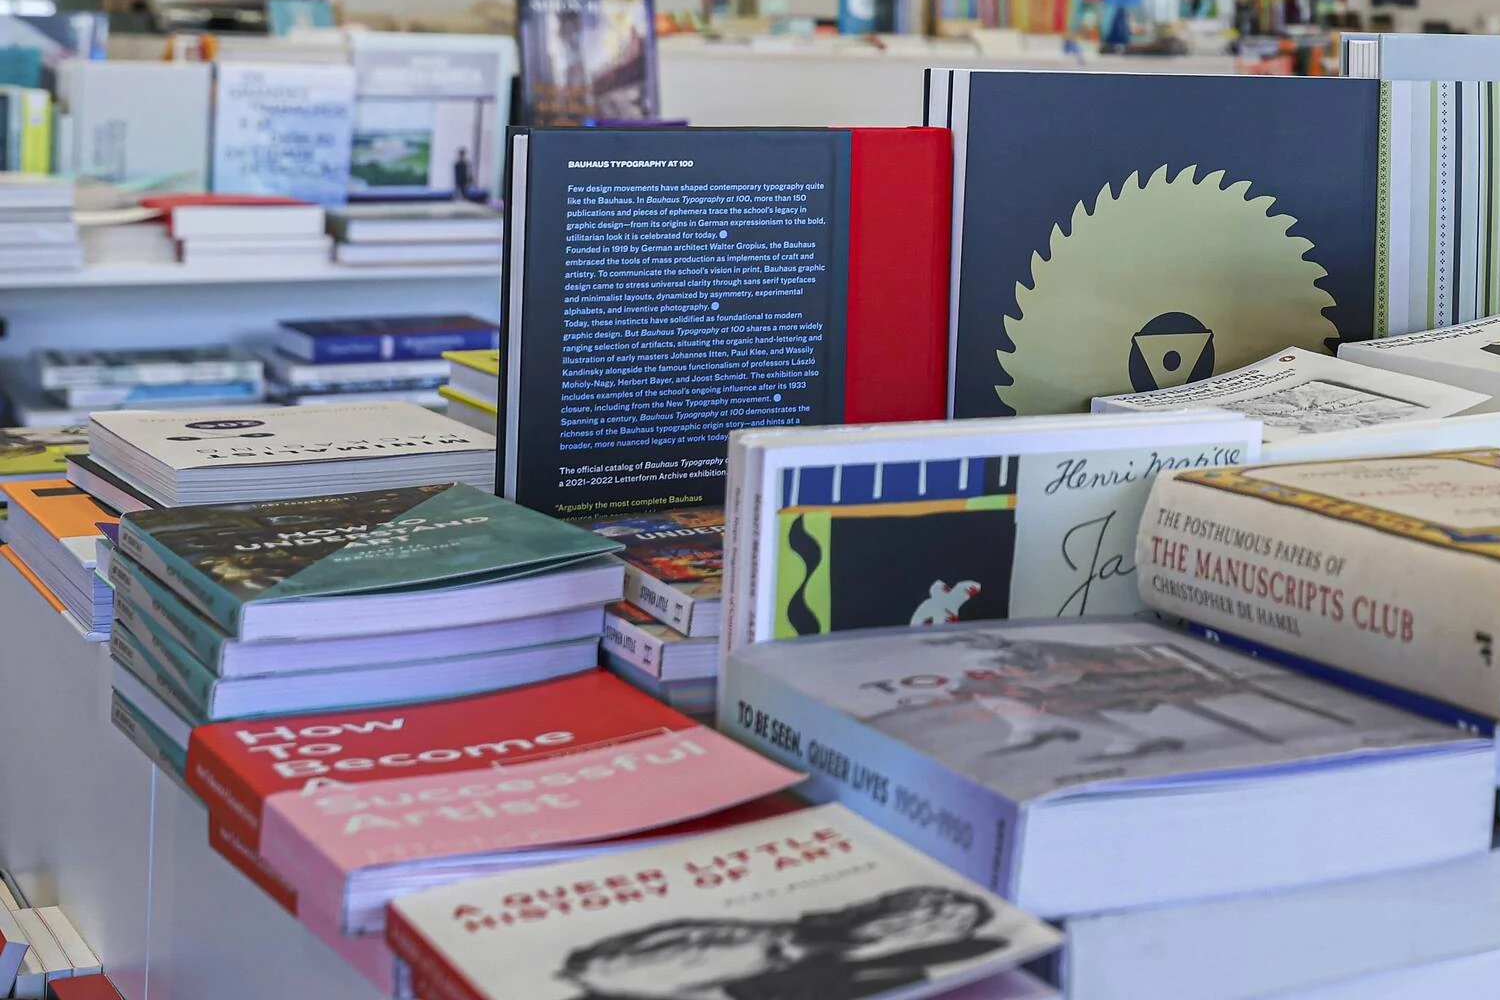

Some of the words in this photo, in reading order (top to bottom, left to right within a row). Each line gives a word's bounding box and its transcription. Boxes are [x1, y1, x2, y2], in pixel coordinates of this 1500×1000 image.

[568, 160, 609, 168] BAUHAUS
[611, 160, 666, 168] TYPOGRAPHY
[667, 160, 679, 168] AT
[680, 160, 694, 168] 100
[567, 184, 584, 193] Few
[586, 184, 612, 194] design
[680, 183, 708, 193] shaped
[709, 183, 761, 193] contemporary
[763, 182, 804, 192] typography
[805, 181, 824, 191] quite
[567, 197, 581, 205] like
[598, 196, 635, 204] Bauhaus.
[636, 196, 645, 204] In
[646, 196, 680, 204] Bauhaus
[681, 195, 725, 206] Typography
[726, 195, 734, 203] at
[735, 195, 753, 204] 100,
[775, 194, 792, 202] than
[234, 516, 489, 551] UNDERSTAND
[276, 523, 369, 541] HOW
[377, 518, 427, 528] TO
[344, 535, 410, 549] ART
[1157, 507, 1180, 529] THE
[1183, 511, 1273, 557] POSTHUMOUS
[1274, 540, 1322, 569] PAPERS
[1324, 555, 1347, 577] OF
[1151, 536, 1190, 574] THE
[1194, 550, 1344, 622] MANUSCRIPTS
[1352, 595, 1415, 643] CLUB
[1152, 574, 1234, 614] CHRISTOPHER
[1257, 608, 1302, 637] HAMEL
[738, 700, 753, 728] TO
[755, 710, 769, 736] BE
[808, 738, 850, 782] QUEER
[852, 762, 889, 805] LIVES
[299, 776, 355, 796] A
[503, 867, 665, 908] QUEER
[684, 827, 838, 875] LITTLE
[463, 885, 670, 933] HISTORY
